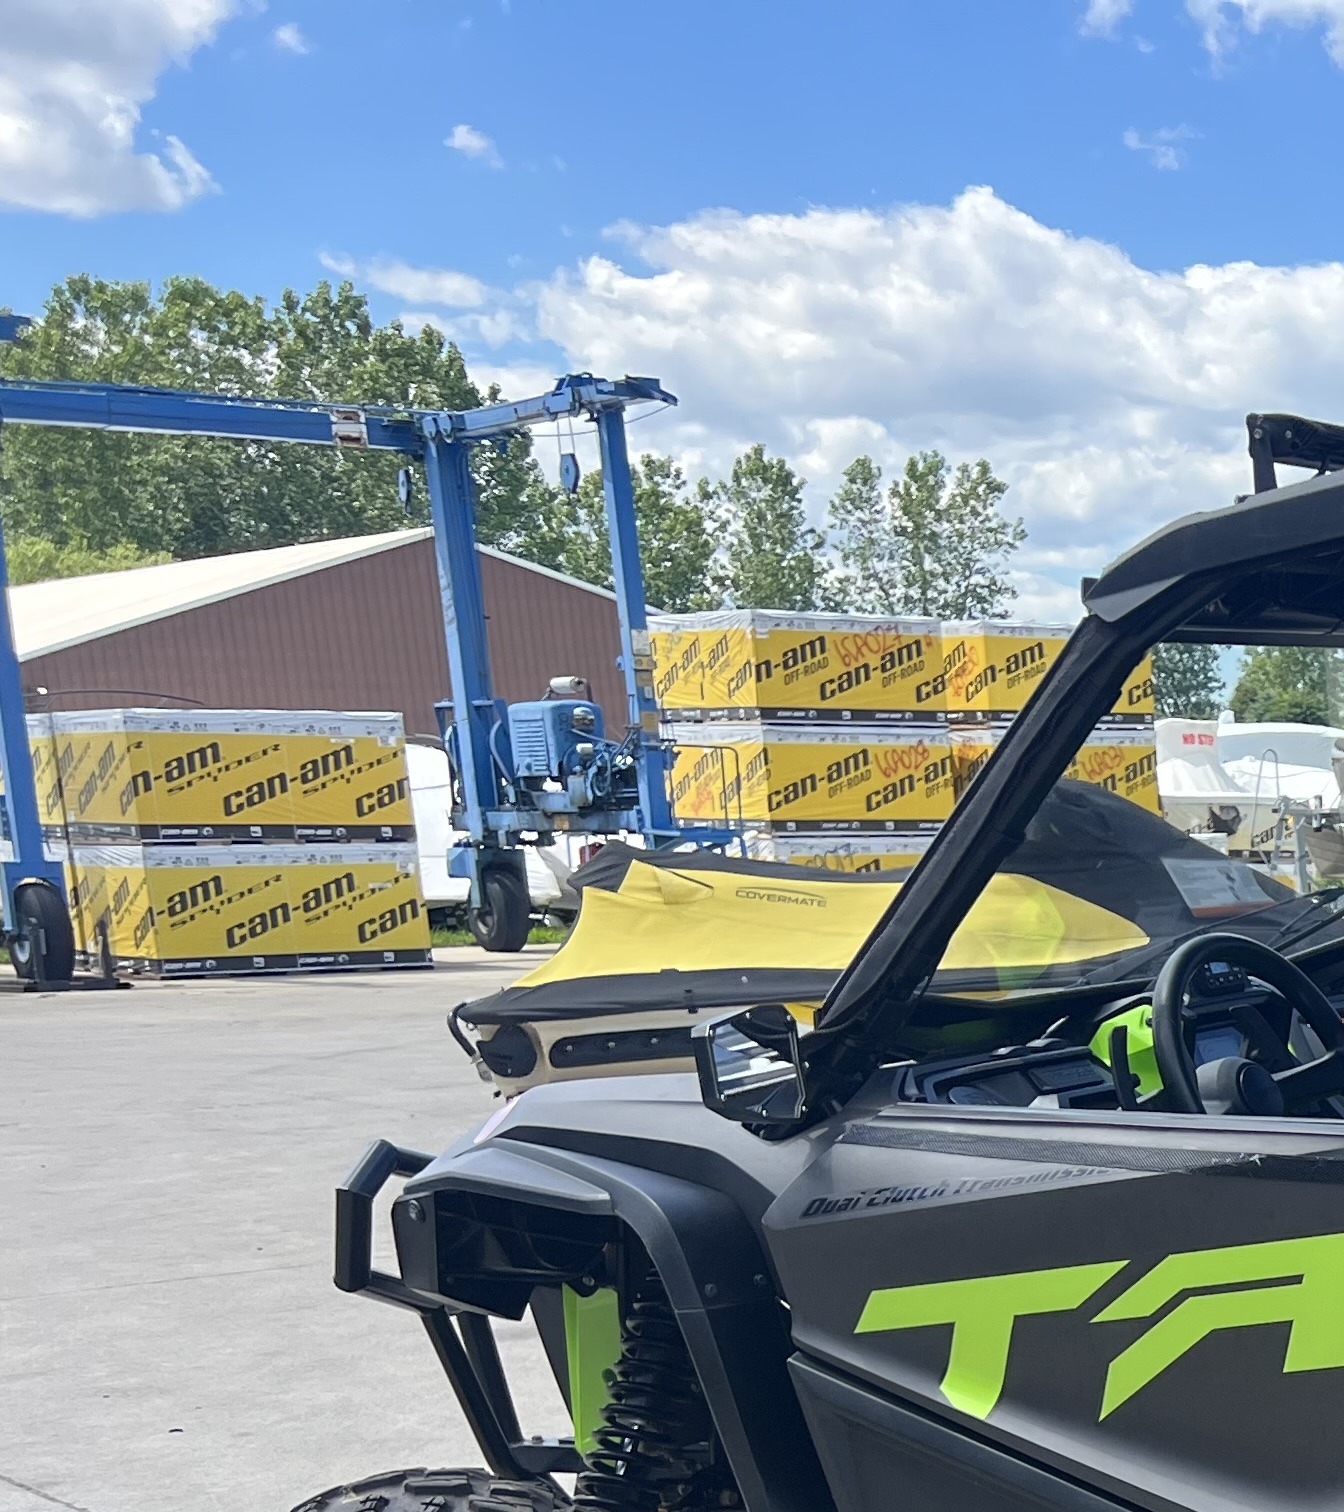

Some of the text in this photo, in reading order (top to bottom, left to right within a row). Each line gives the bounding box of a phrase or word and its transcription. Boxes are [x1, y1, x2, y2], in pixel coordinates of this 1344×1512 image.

[784, 656, 829, 686] OFF-ROAD
[820, 638, 923, 701] can-am
[965, 641, 1045, 704] can-am
[223, 744, 354, 818] can-am
[768, 747, 870, 813] can-am
[828, 768, 872, 799] OFF-ROAD
[226, 871, 356, 950] can-am
[735, 888, 828, 909] COVERMATE
